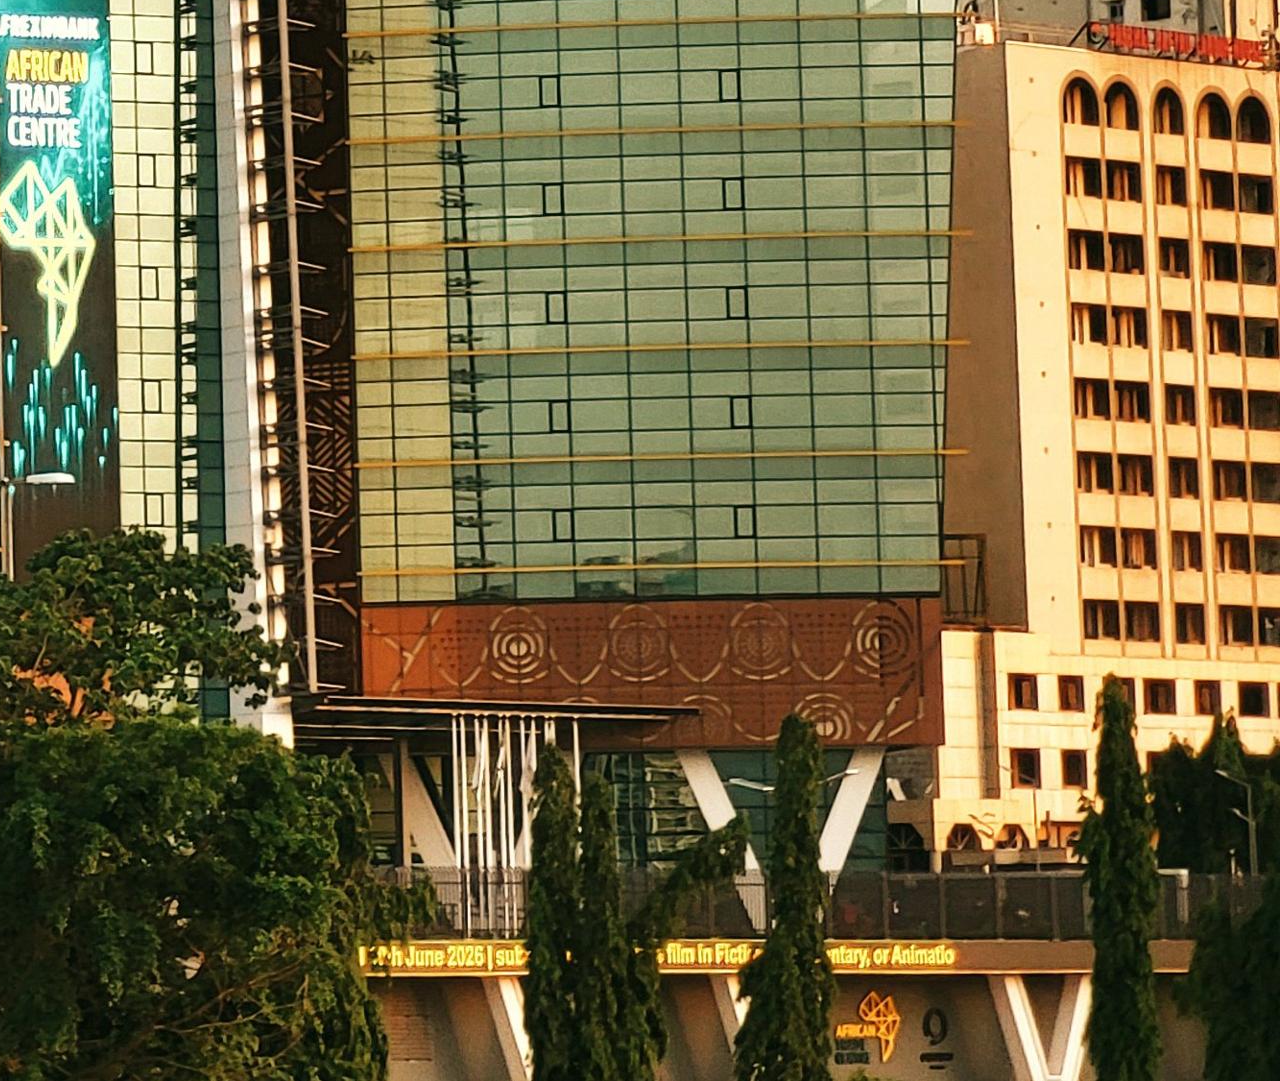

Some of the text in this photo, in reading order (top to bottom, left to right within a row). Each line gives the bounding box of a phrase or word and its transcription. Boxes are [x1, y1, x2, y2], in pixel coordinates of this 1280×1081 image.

[5, 49, 89, 83] AFRICAN
[5, 83, 72, 115] TRADE
[7, 115, 82, 148] CENTRE
[405, 944, 444, 967] June
[447, 945, 484, 967] 2026
[666, 943, 696, 964] film
[697, 943, 713, 964] in
[873, 948, 890, 965] or
[891, 945, 955, 966] Animatio
